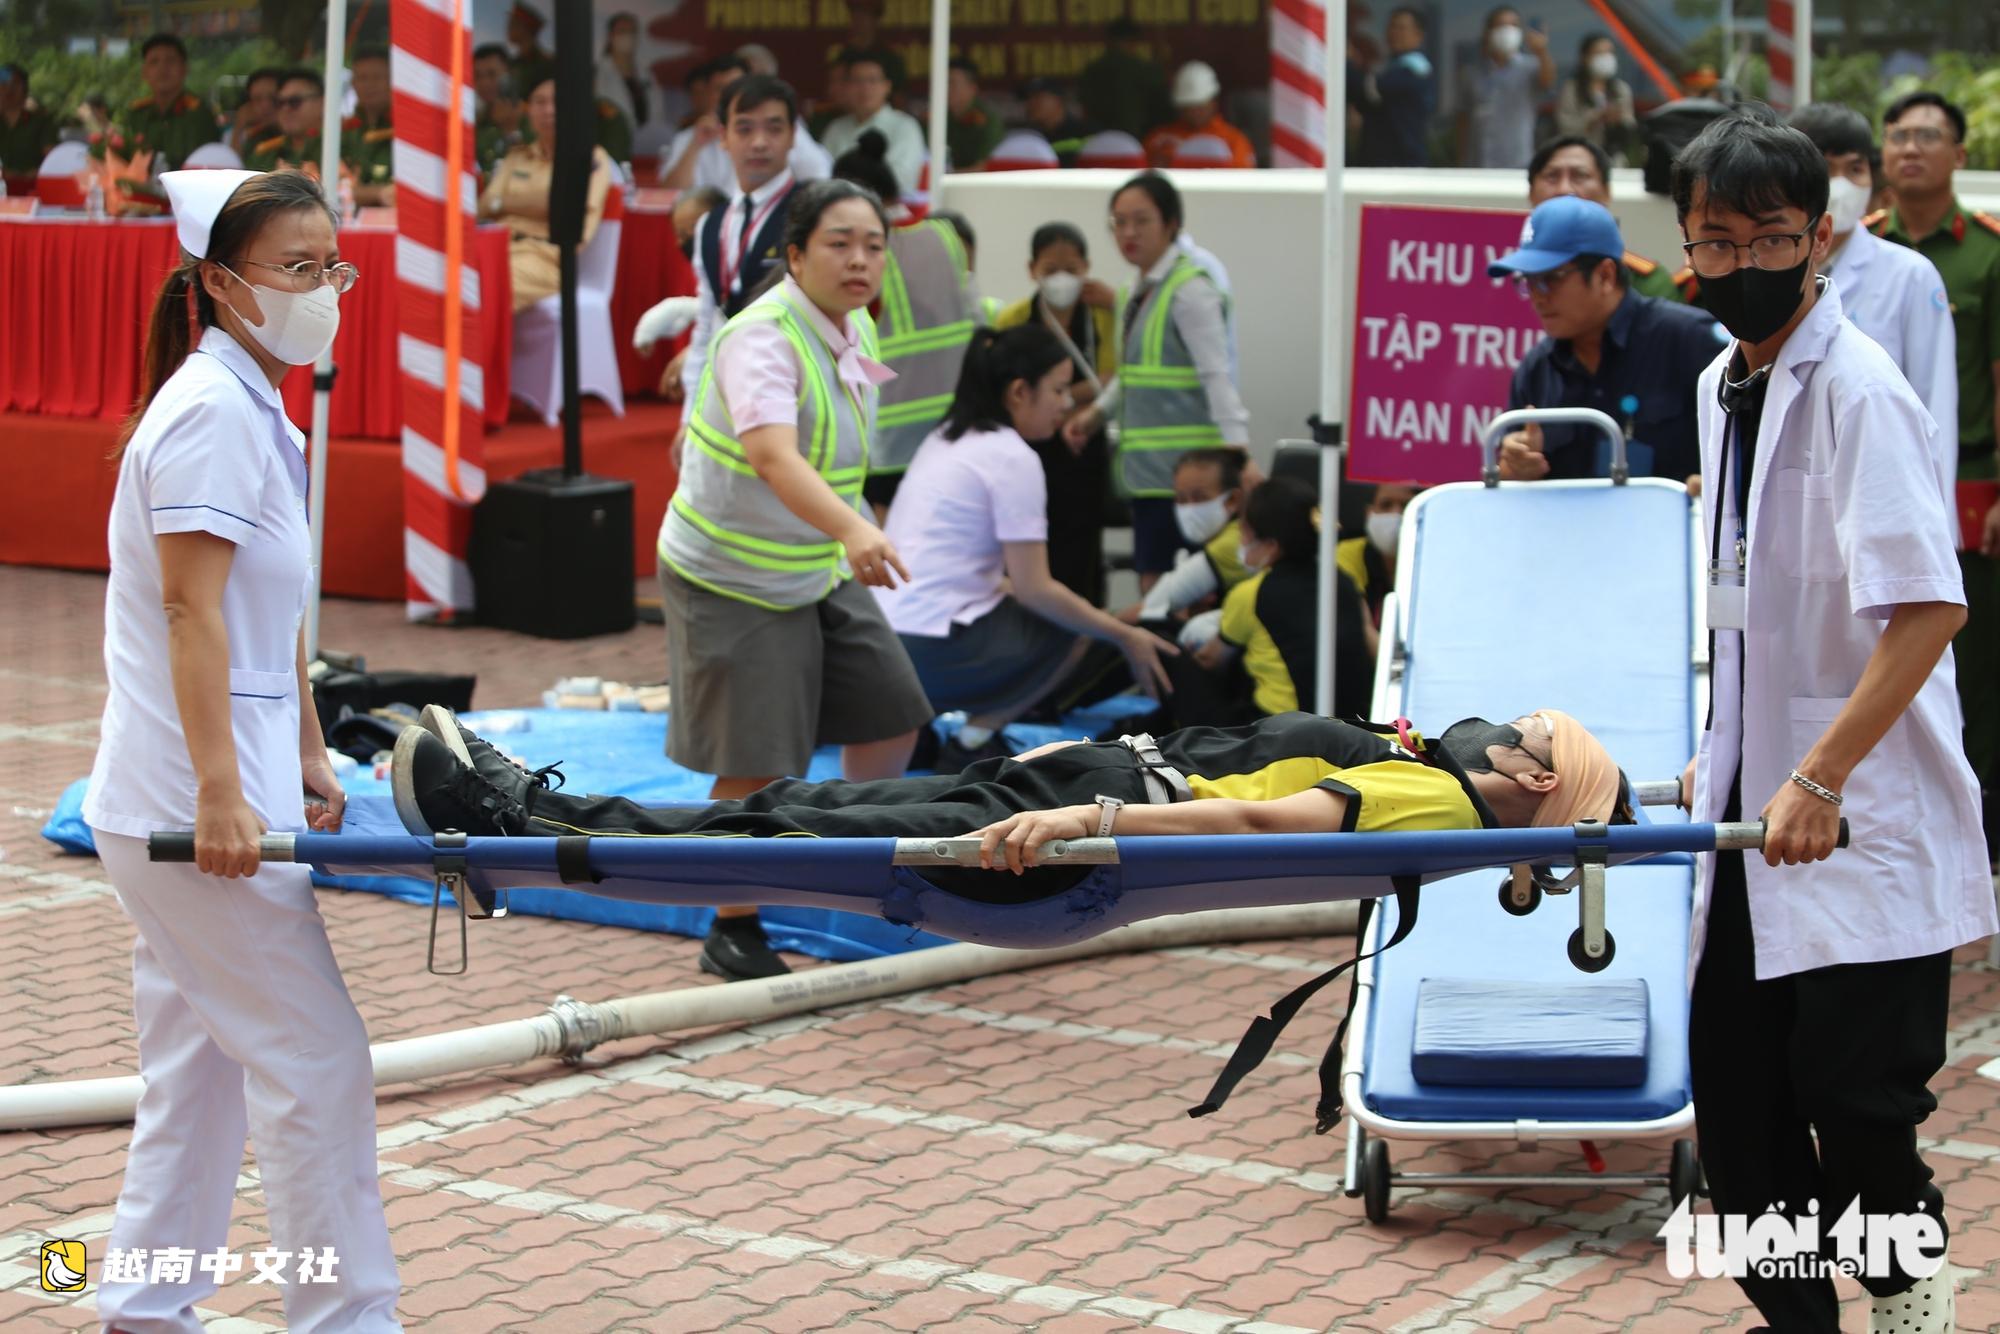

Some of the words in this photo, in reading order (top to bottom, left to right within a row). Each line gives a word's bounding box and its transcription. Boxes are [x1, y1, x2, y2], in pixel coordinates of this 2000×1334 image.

[1388, 239, 1475, 287] KHU
[1362, 312, 1442, 371] TẬP
[1451, 322, 1547, 369] TRU
[1366, 396, 1451, 451] NẠN
